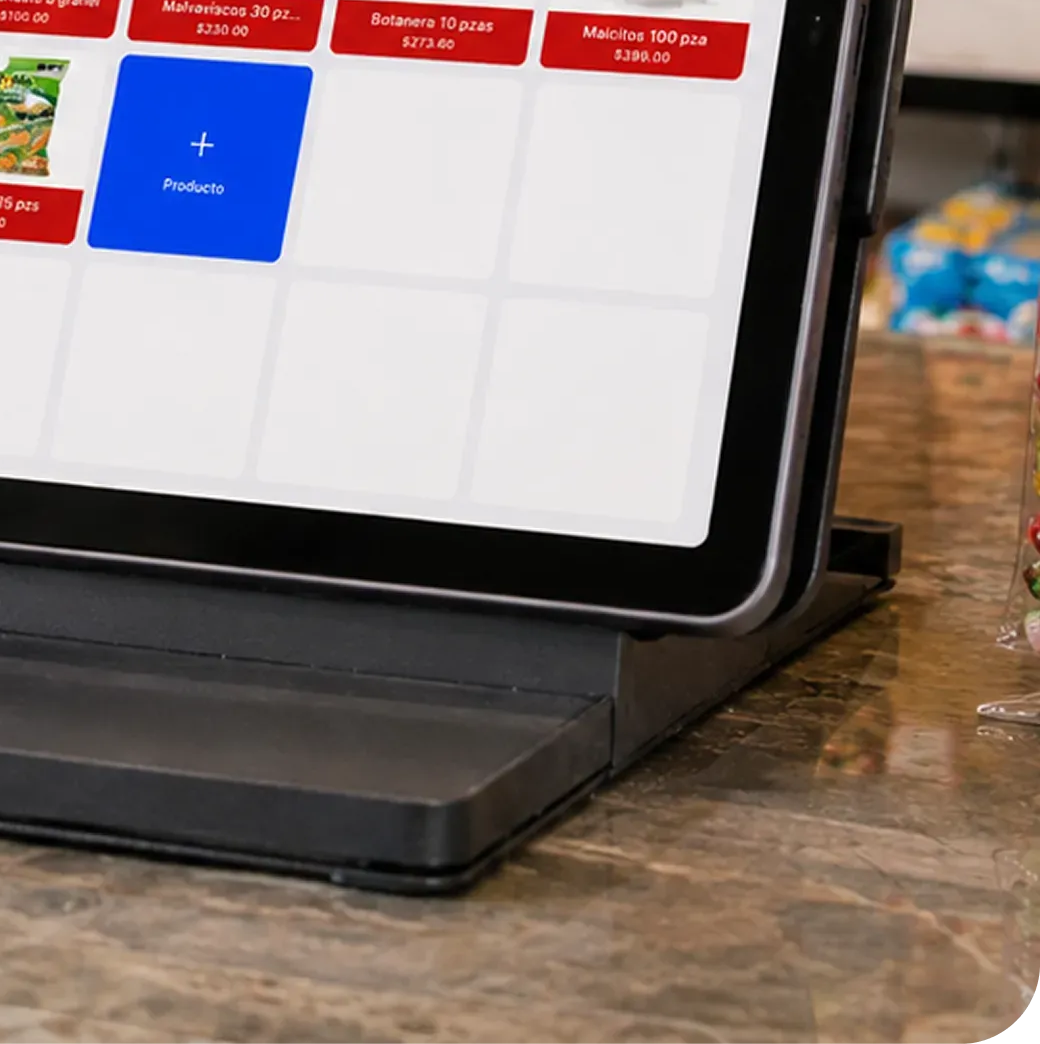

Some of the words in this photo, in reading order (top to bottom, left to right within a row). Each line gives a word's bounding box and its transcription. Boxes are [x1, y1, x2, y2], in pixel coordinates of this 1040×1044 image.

[249, 4, 270, 19] 30
[370, 11, 435, 30] Botanera
[440, 14, 457, 31] 10
[458, 19, 494, 34] pzas
[649, 29, 678, 46] 100
[679, 33, 708, 49] pza
[162, 177, 225, 195] Producto
[14, 199, 40, 214] pzs
